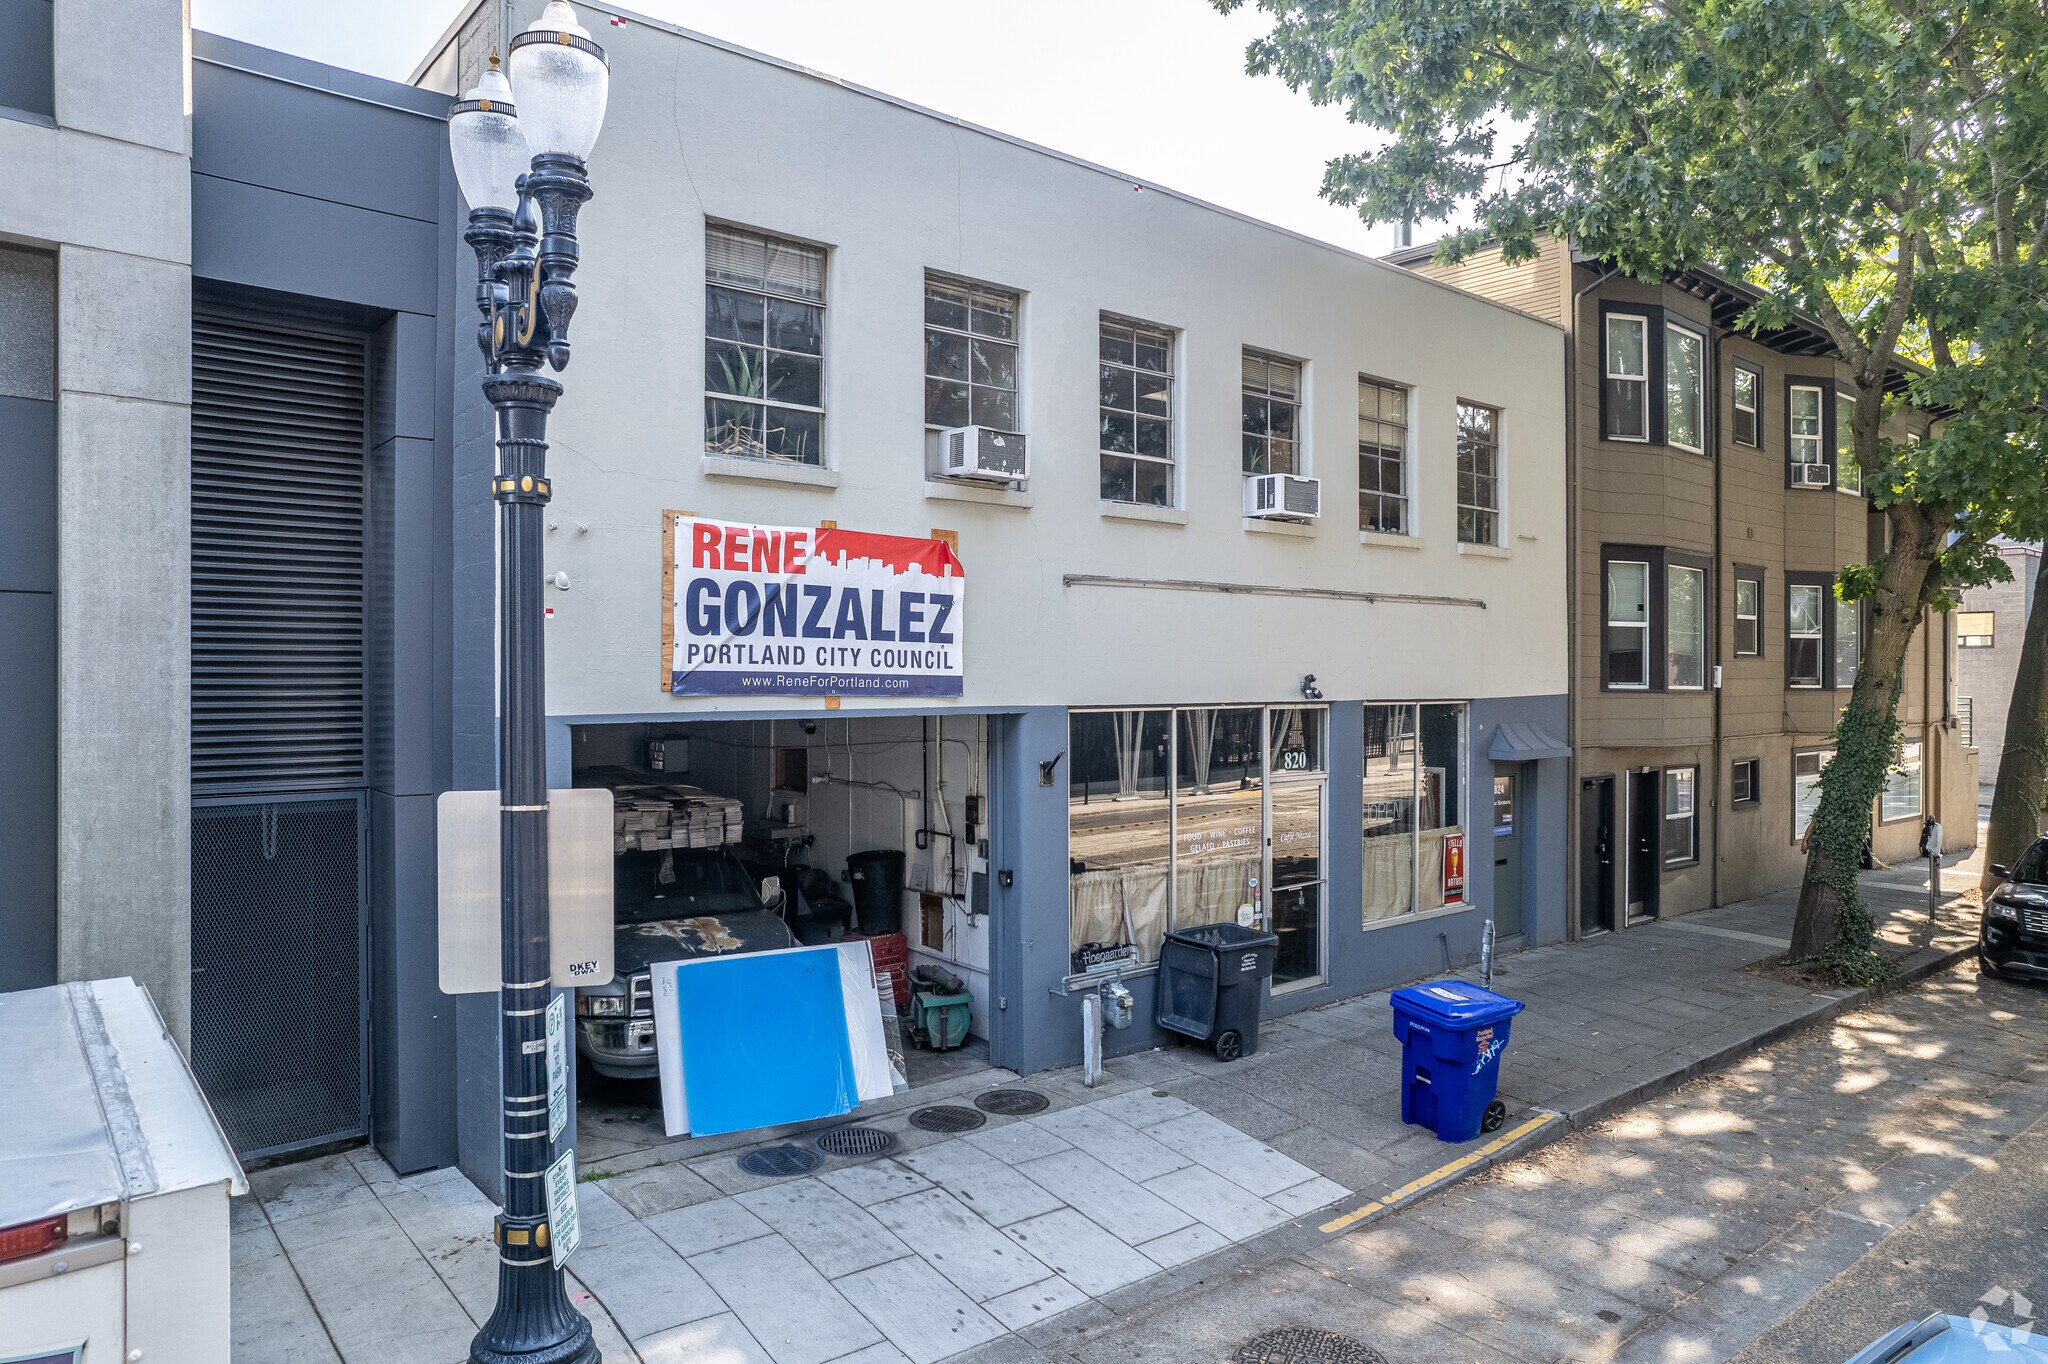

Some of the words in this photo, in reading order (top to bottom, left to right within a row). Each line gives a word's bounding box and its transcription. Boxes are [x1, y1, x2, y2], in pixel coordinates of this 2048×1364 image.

[692, 522, 807, 575] RENE
[686, 577, 954, 644] GONZALEZ
[687, 643, 805, 665] PORTLAND
[816, 647, 861, 667] CITY
[870, 648, 953, 670] COUNCIL
[742, 675, 909, 689] www.ReneForPortland.com
[1284, 752, 1307, 769] 820
[1494, 784, 1504, 795] 824
[1369, 801, 1401, 821] OPEN
[1183, 832, 1202, 842] FOOD
[1209, 830, 1226, 838] WINE
[1234, 826, 1256, 836] COFFEE
[1190, 842, 1215, 853] GELATO
[1222, 838, 1250, 848] PASTRIES
[1447, 839, 1463, 849] STELLA
[1447, 876, 1463, 887] ARTOIS
[1082, 945, 1131, 964] Hoegaarden
[569, 960, 598, 972] DKEY
[552, 1067, 562, 1083] PARK
[552, 1163, 568, 1182] STADIUM
[555, 1172, 567, 1188] EVENT
[553, 1179, 570, 1196] PARKING
[554, 1186, 570, 1206] DISTRICT
[553, 1228, 562, 1239] FOR
[561, 1218, 571, 1234] GAME
[563, 1236, 572, 1251] RATE
